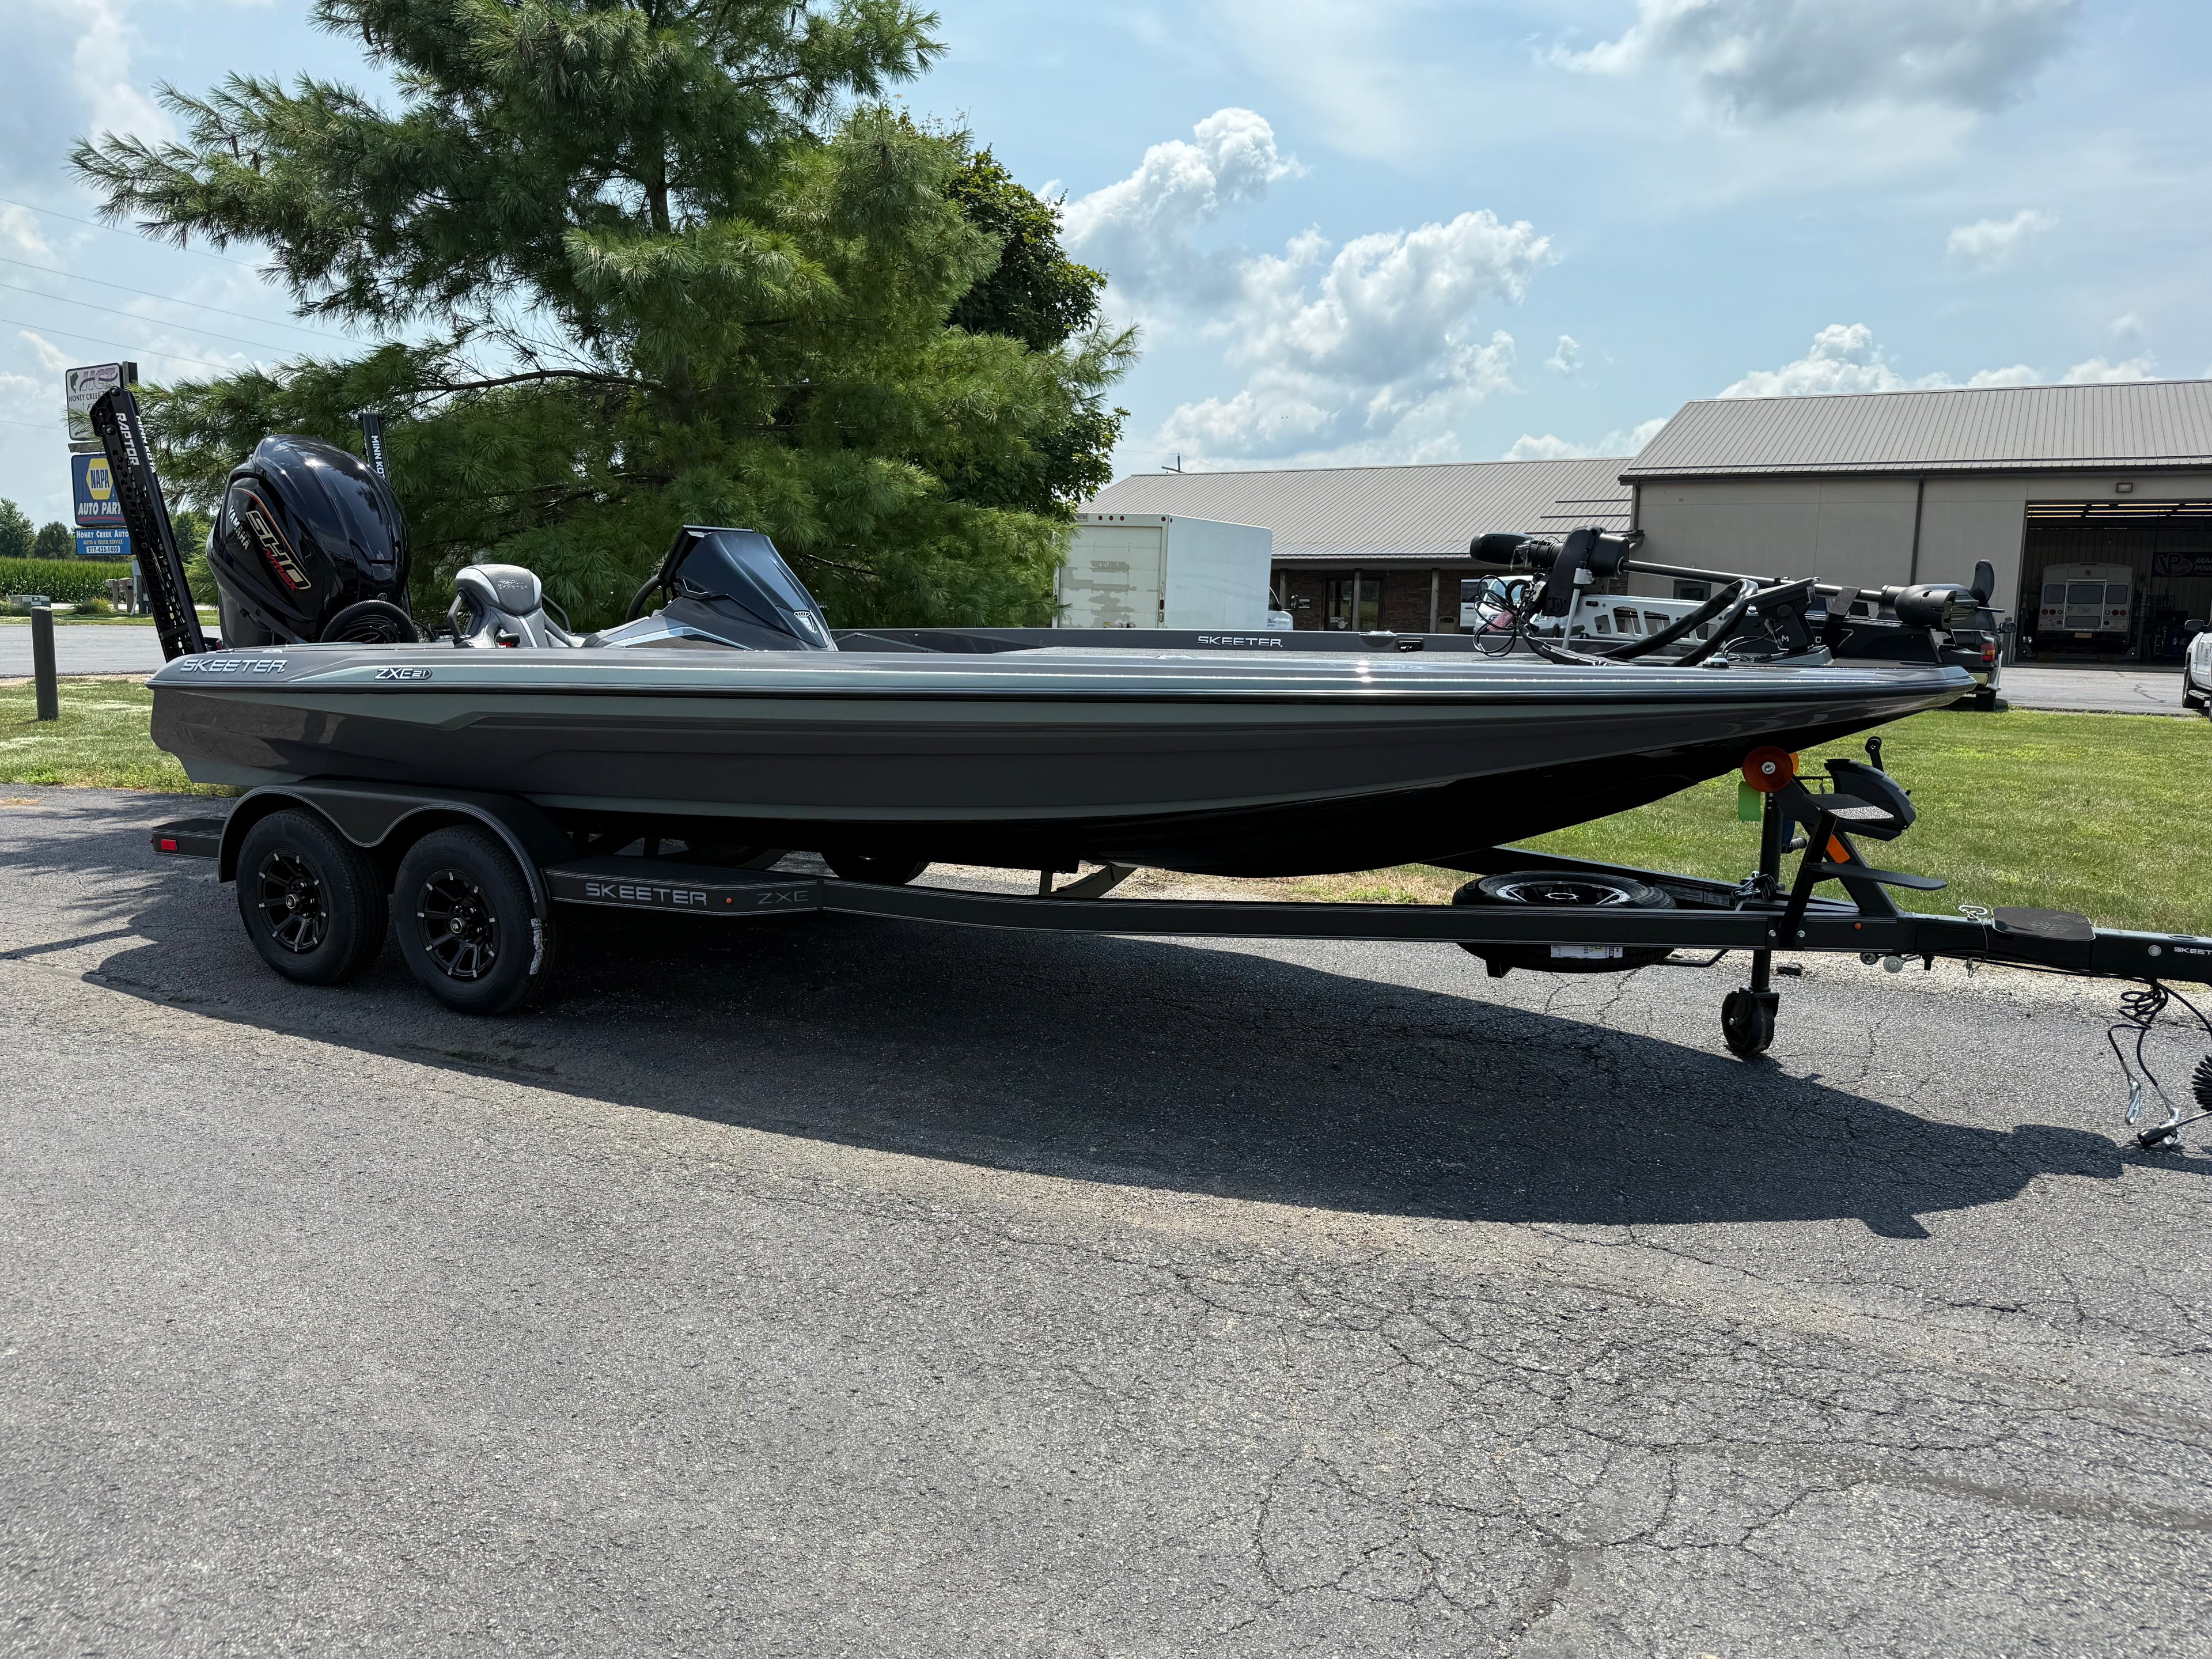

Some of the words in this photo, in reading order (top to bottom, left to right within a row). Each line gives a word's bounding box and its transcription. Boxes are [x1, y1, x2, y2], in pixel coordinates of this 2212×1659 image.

[69, 394, 85, 403] HONEY
[116, 412, 140, 465] RAPTOR
[371, 435, 382, 460] MINN
[90, 469, 109, 488] NAPA
[78, 502, 99, 515] AUTO
[101, 502, 122, 514] PART
[96, 530, 112, 538] CREEK
[228, 505, 251, 550] YAMAHA
[245, 510, 312, 590] SHO
[1198, 636, 1283, 647] SKEETER
[180, 659, 288, 673] SKEETER
[585, 882, 707, 906] SKEETER
[757, 891, 809, 904] ZXE
